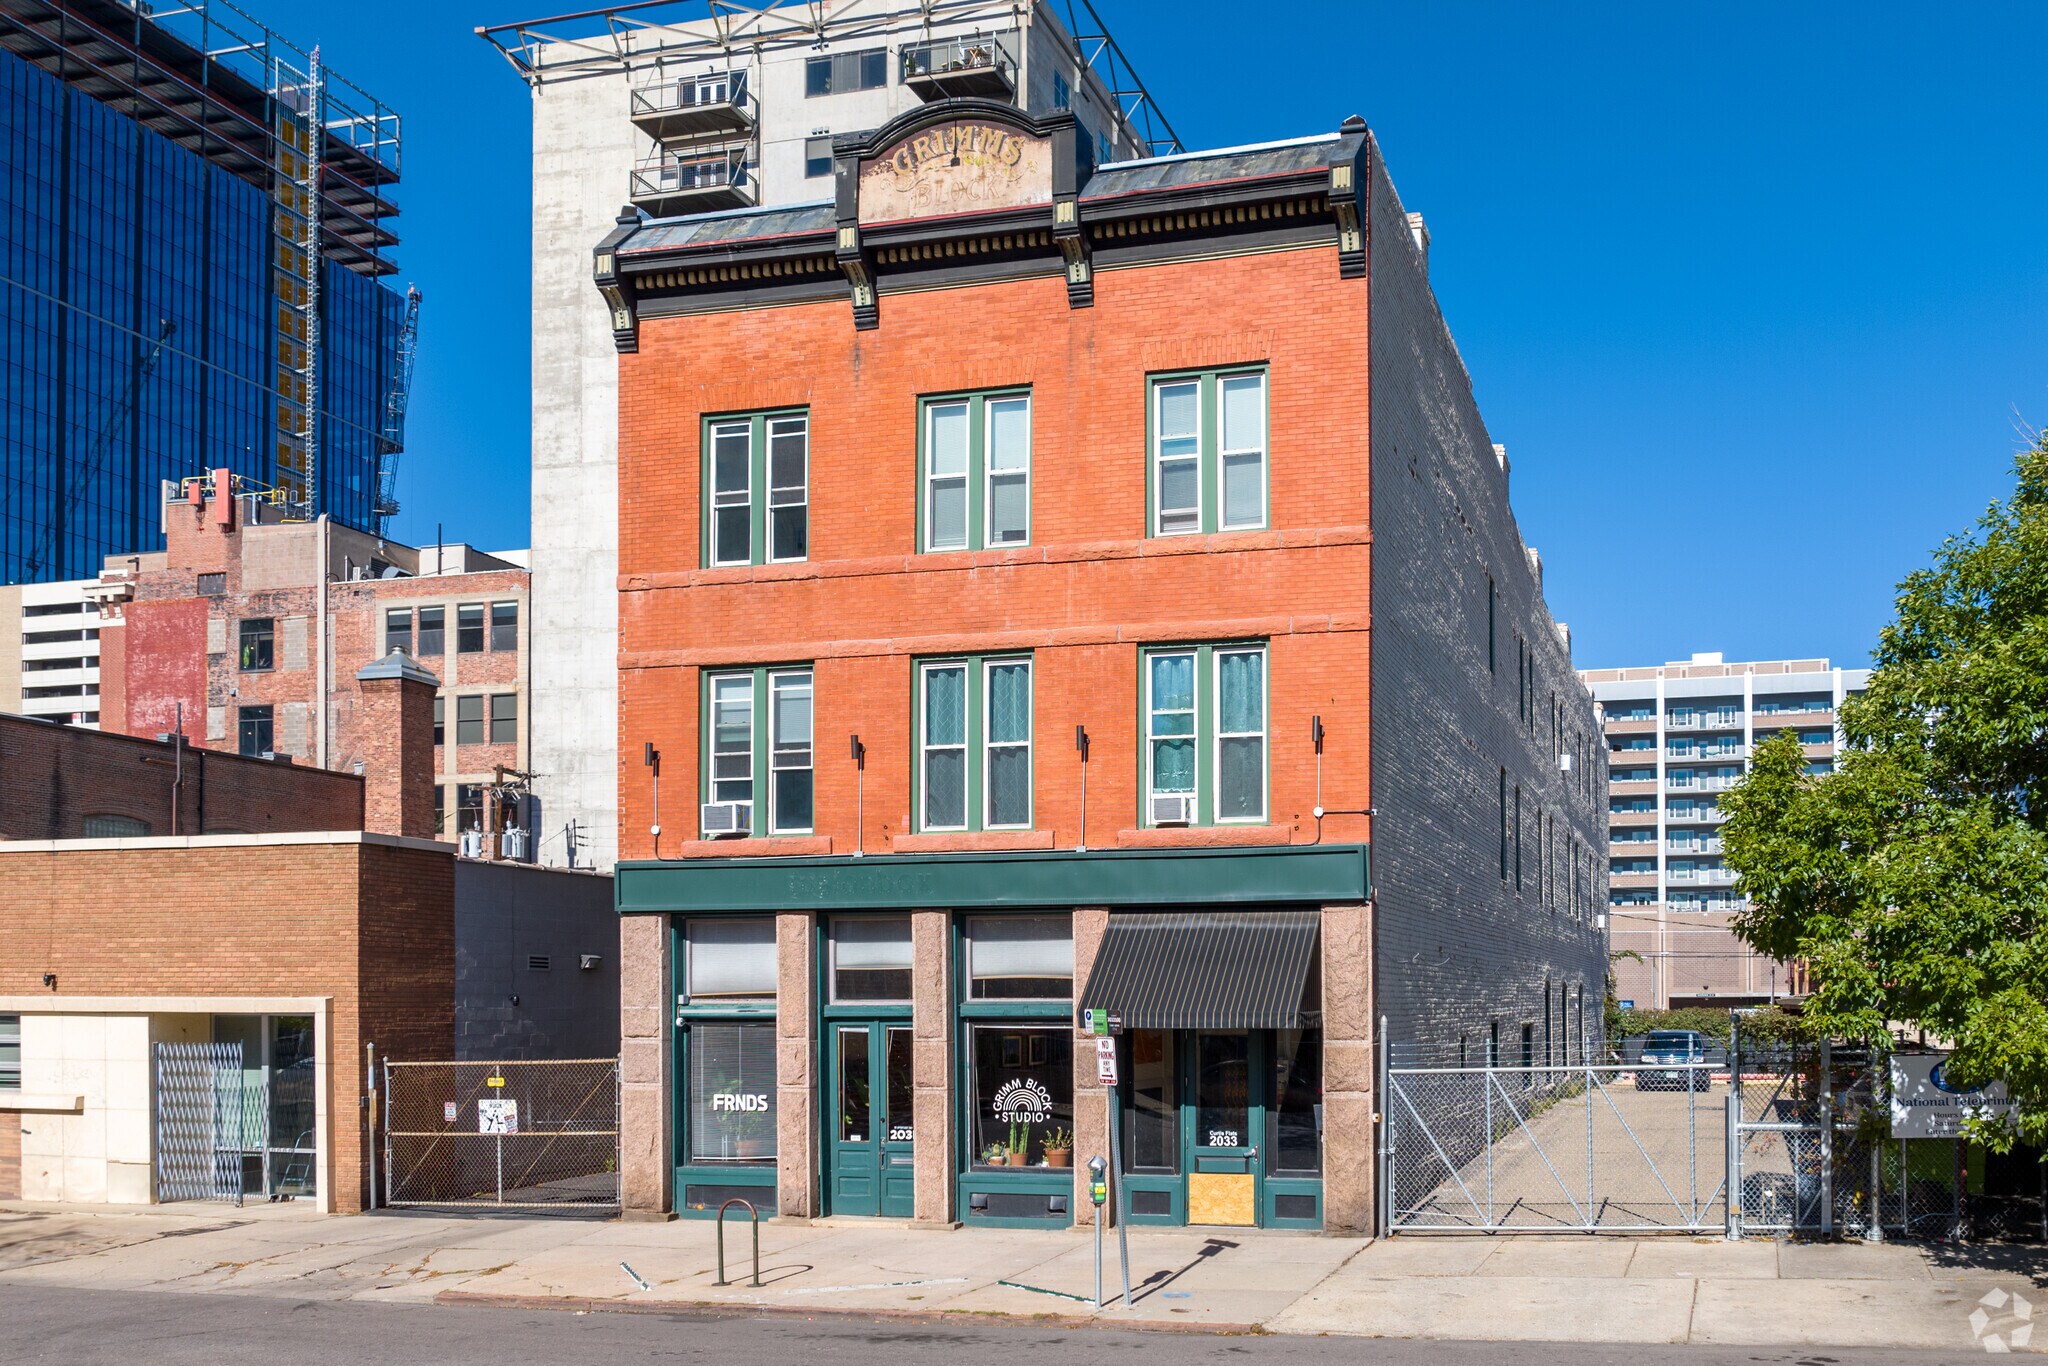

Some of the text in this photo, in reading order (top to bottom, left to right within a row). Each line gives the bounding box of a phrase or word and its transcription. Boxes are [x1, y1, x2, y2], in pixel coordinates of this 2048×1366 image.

[892, 125, 1025, 175] GRIMMS
[914, 174, 999, 208] BLOCK
[1101, 1040, 1109, 1049] NO
[1098, 1051, 1114, 1060] PARKING
[993, 1078, 1052, 1111] GRIMM BLOCK
[713, 1094, 768, 1112] FRNDS
[1896, 1096, 1949, 1108] National
[1002, 1111, 1044, 1123] STUDIO
[890, 1129, 915, 1140] 203
[1209, 1135, 1238, 1147] 2033
